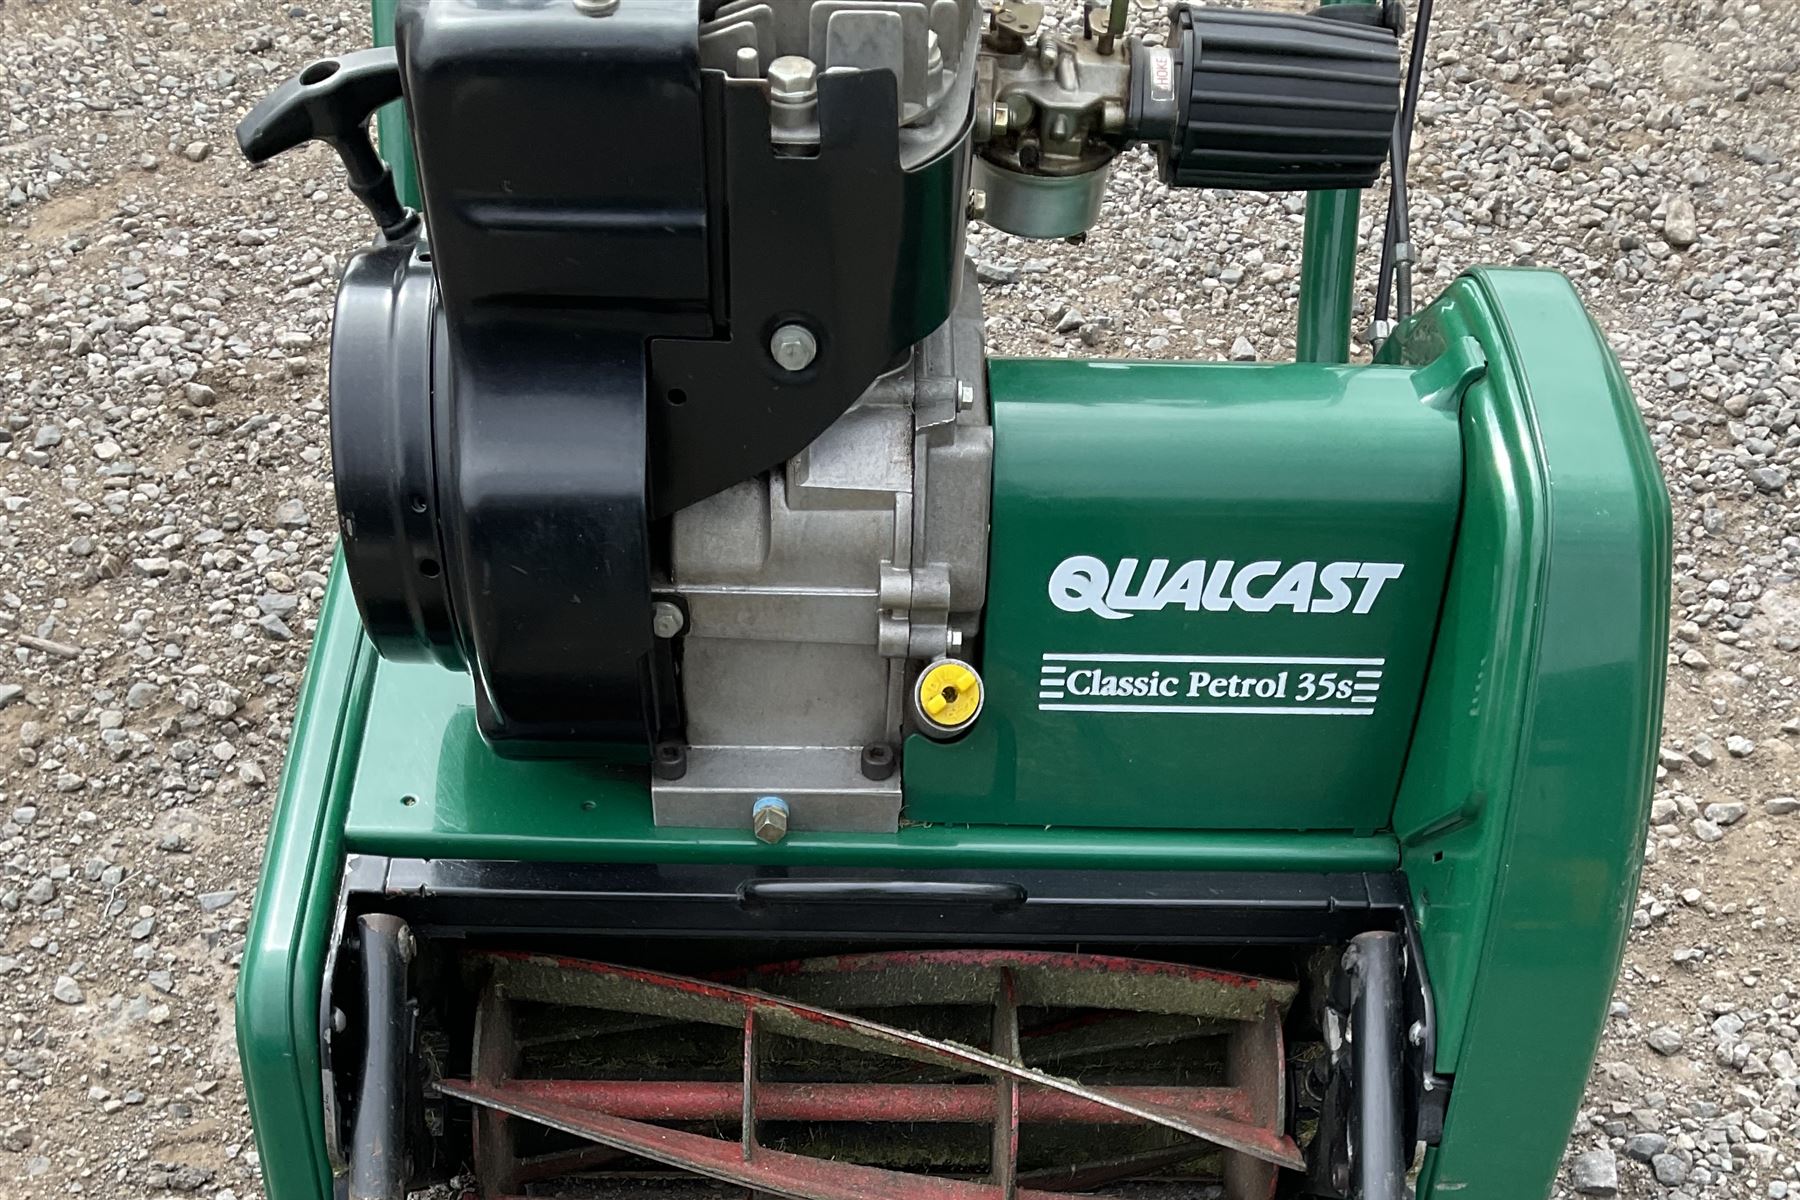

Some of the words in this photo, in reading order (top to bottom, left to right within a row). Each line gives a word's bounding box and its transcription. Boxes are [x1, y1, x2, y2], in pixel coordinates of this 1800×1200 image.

[1155, 57, 1169, 89] HOKE
[1048, 555, 1405, 620] QUALCAST
[1066, 668, 1179, 697] Classic
[1186, 671, 1288, 698] Petrol
[1295, 671, 1353, 701] 35s
